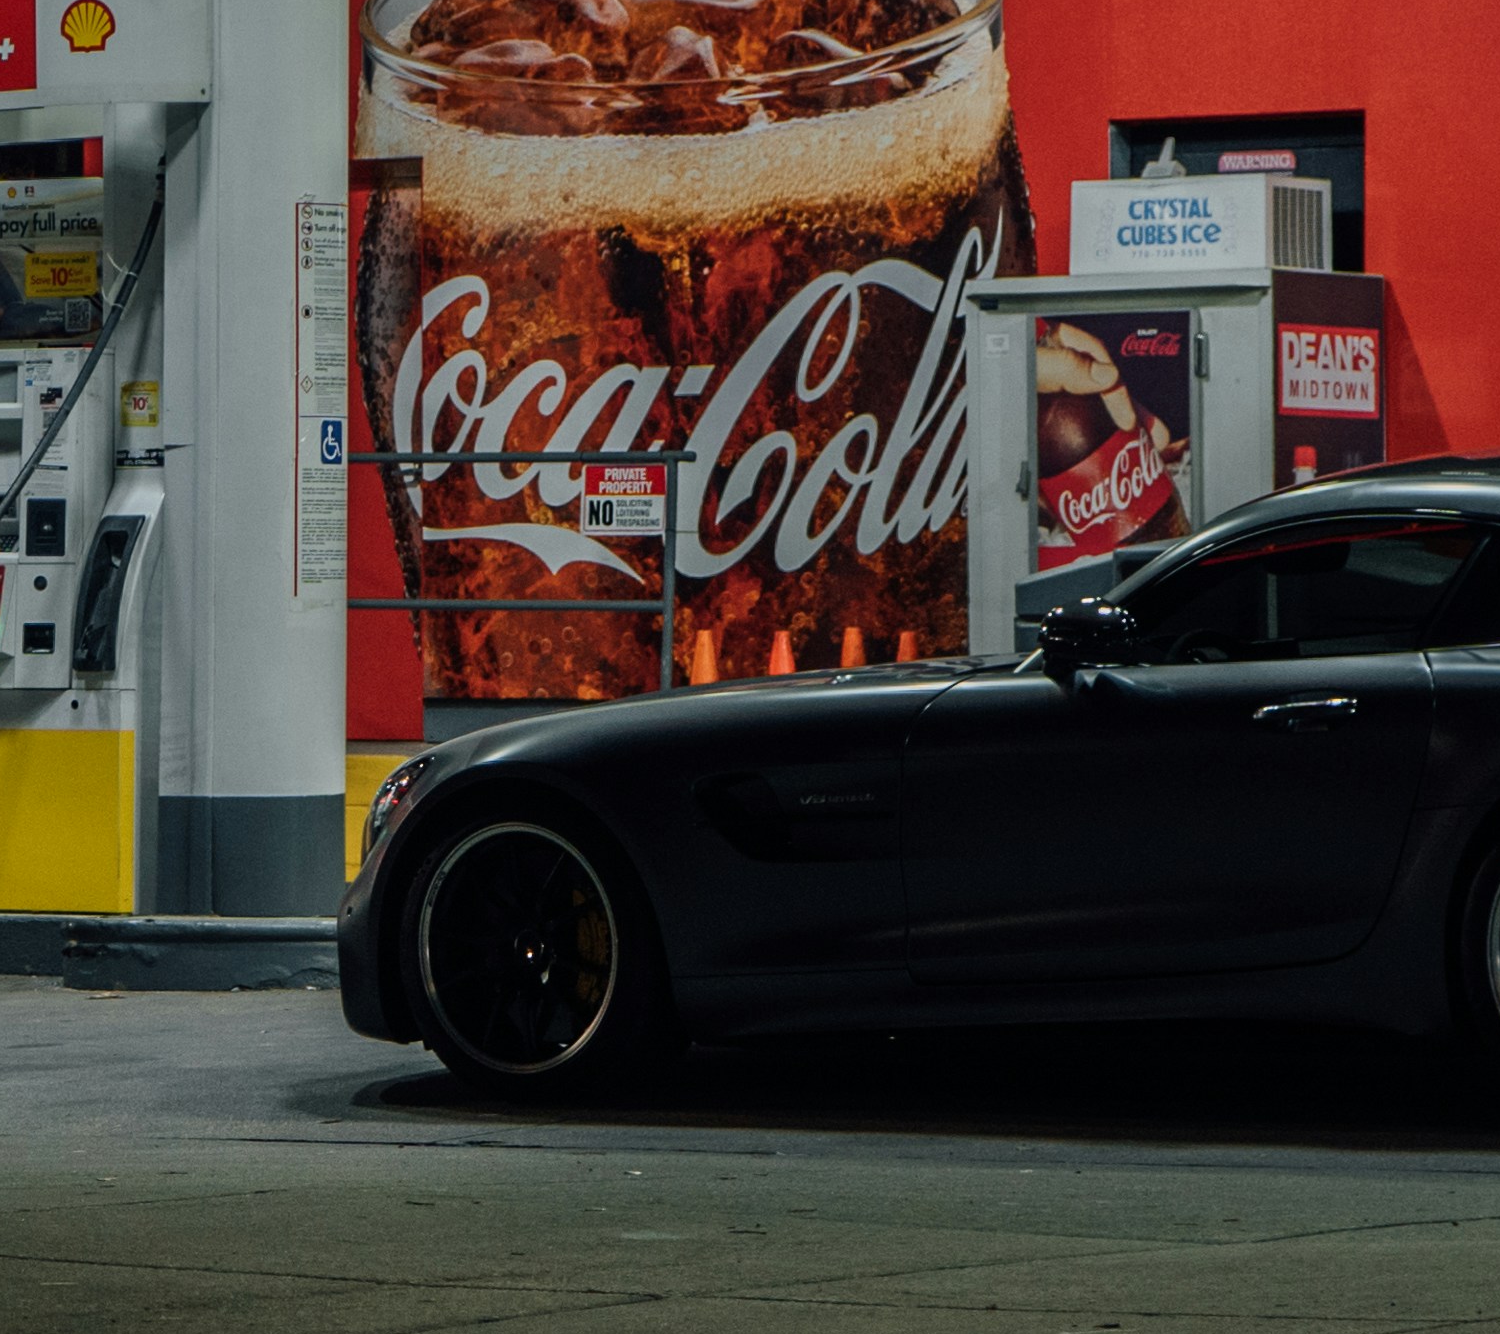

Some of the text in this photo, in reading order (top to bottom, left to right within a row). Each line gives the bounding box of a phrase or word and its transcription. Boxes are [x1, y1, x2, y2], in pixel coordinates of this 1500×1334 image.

[1222, 154, 1291, 169] WARNING
[1128, 198, 1213, 220] CRYSTAL
[0, 219, 28, 239] pay
[32, 213, 56, 232] full
[60, 212, 98, 236] price
[1117, 225, 1177, 246] CUBES
[1121, 332, 1182, 357] Coca-Cola
[1281, 330, 1376, 373] DEAN'S
[1289, 379, 1369, 400] MIDTOWN
[603, 468, 646, 480] PRIVATE
[1058, 427, 1164, 534] Coca-Cola
[598, 481, 653, 494] PROPERTY
[588, 500, 613, 526] NO
